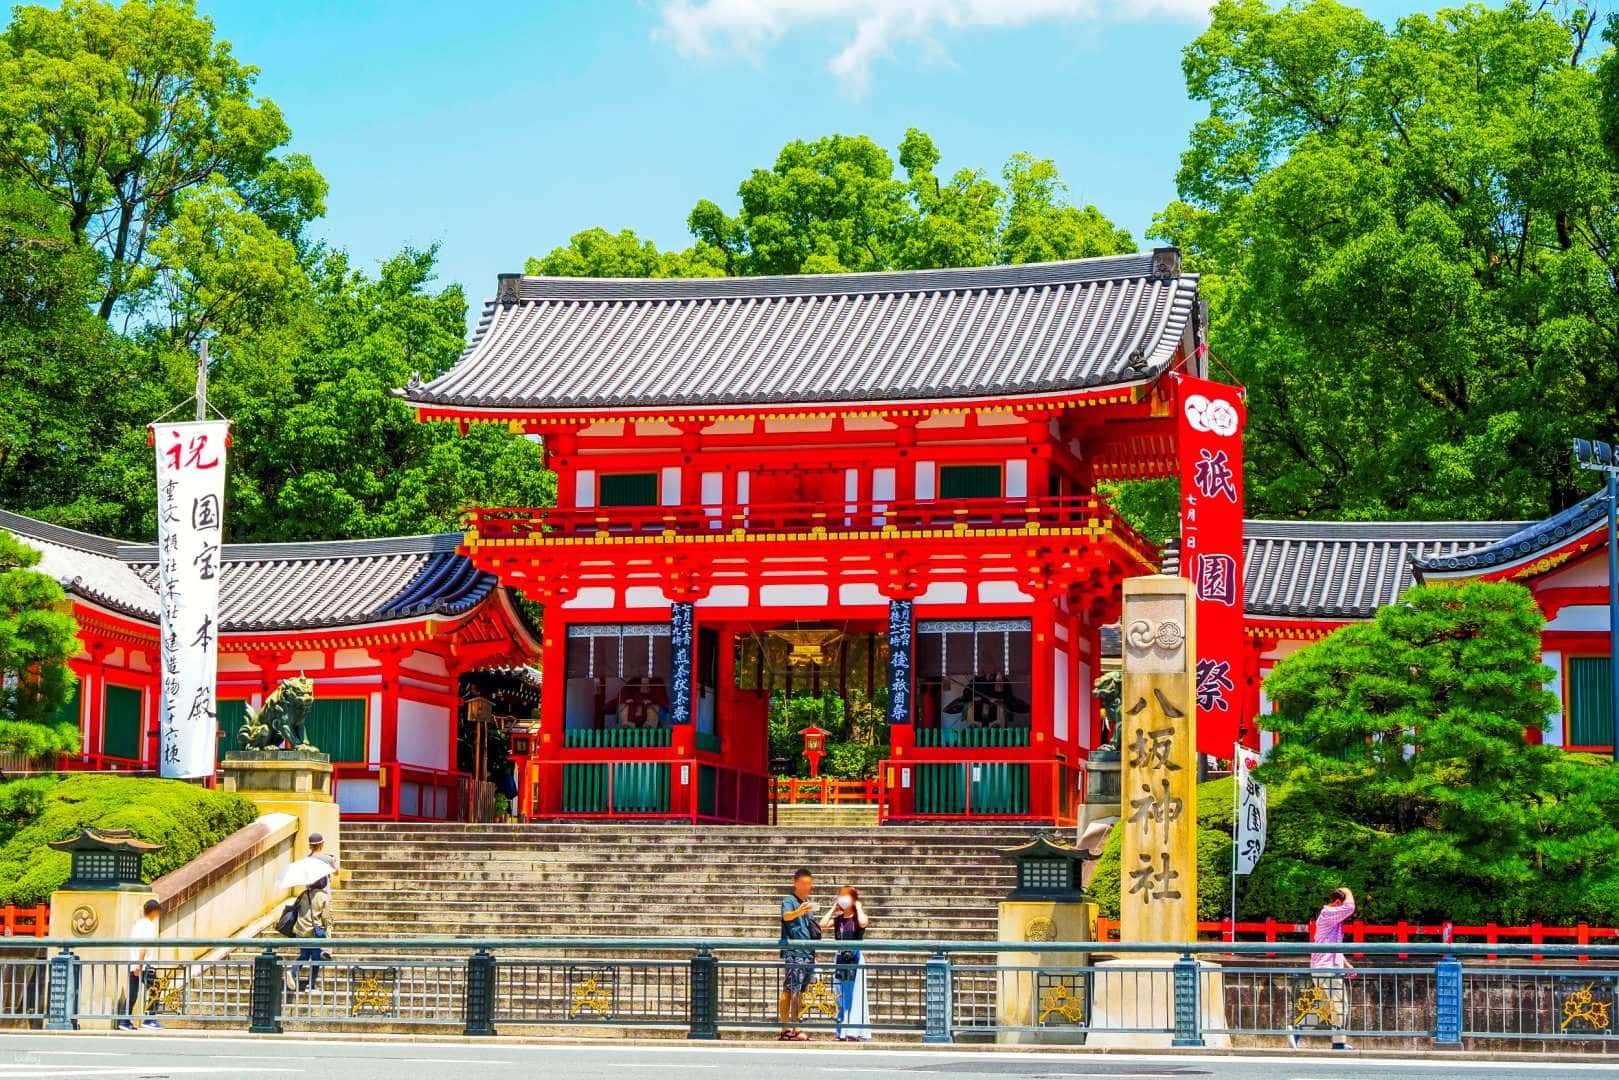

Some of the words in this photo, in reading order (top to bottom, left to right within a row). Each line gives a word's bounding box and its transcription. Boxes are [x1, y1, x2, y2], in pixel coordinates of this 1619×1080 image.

[166, 430, 219, 471] 祝
[1193, 448, 1238, 713] 祇園祭
[1126, 688, 1185, 905] 八坂神社
